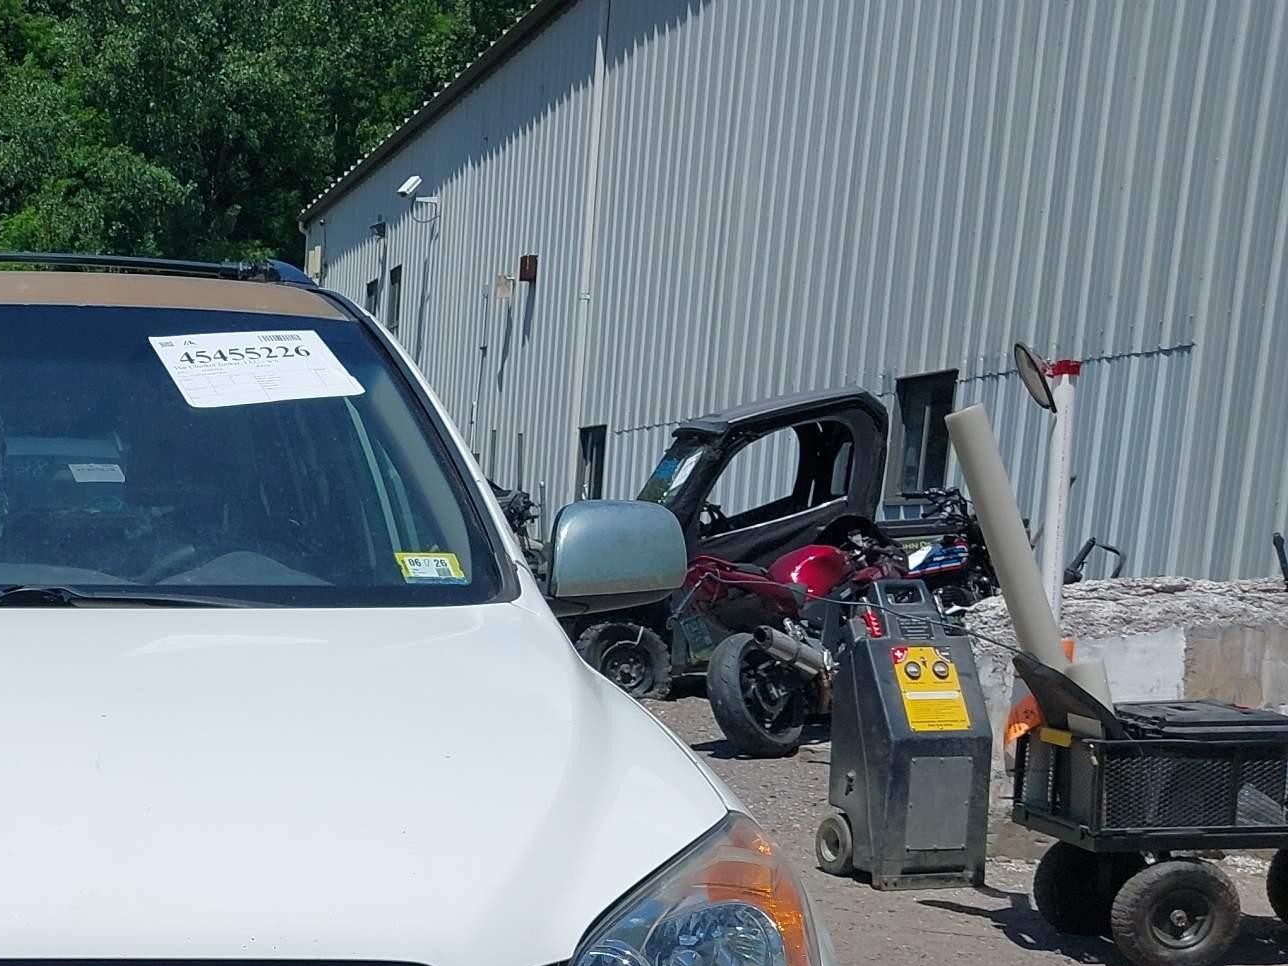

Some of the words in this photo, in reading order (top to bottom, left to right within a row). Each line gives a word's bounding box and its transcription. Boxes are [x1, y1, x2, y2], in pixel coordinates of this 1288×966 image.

[179, 345, 311, 362] 45455226
[408, 558, 422, 567] 06
[433, 559, 448, 568] 26
